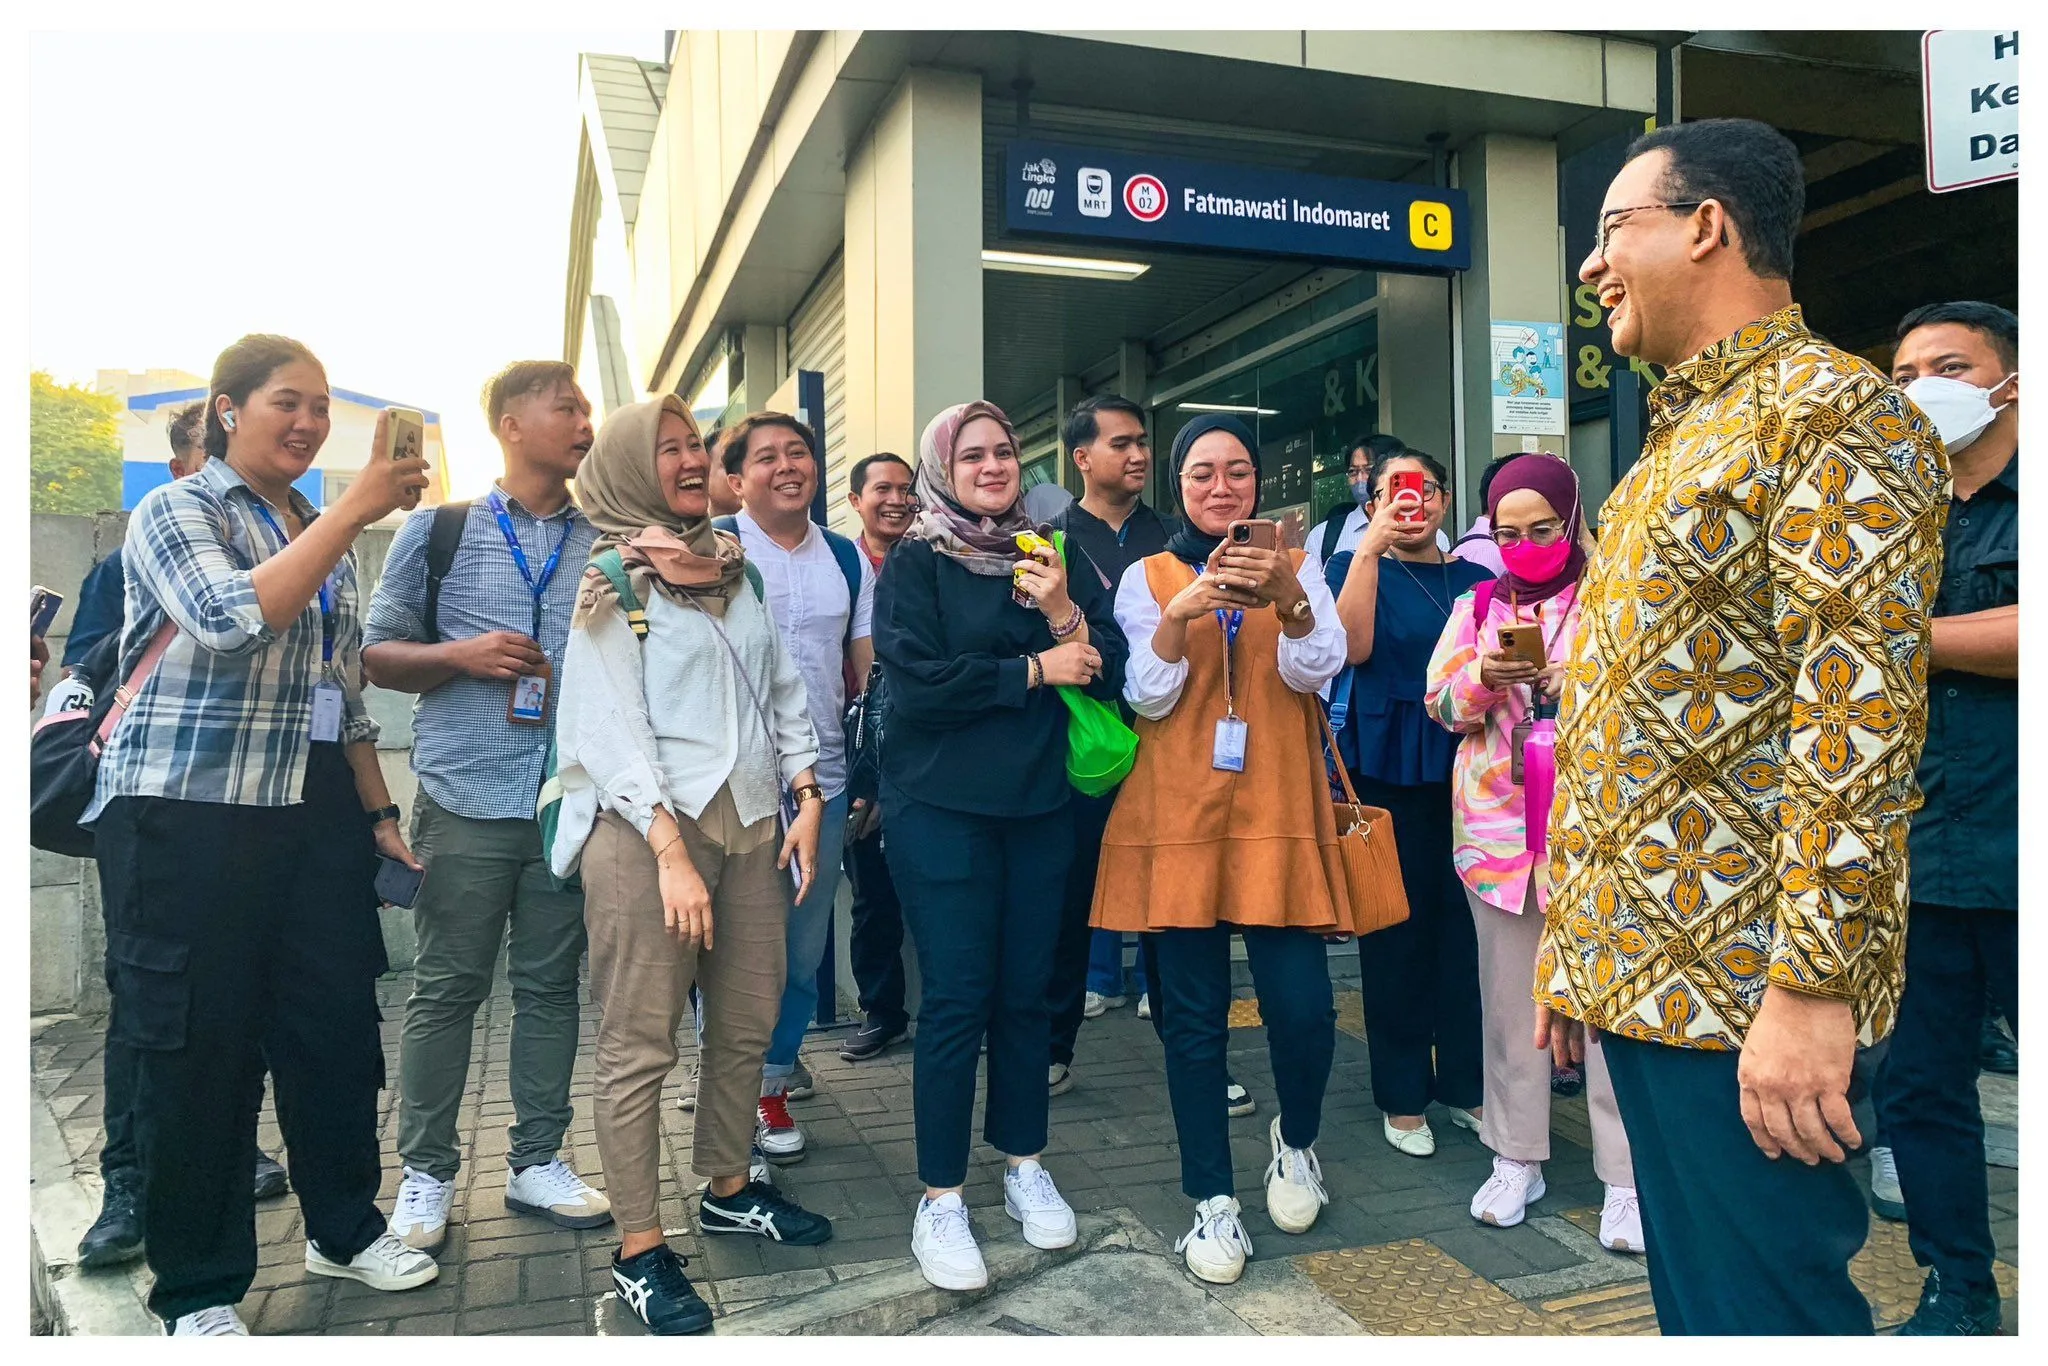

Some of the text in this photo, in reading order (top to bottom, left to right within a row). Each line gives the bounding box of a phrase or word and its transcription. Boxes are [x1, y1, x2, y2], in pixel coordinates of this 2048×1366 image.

[1022, 162, 1039, 173] Jak
[1022, 171, 1056, 185] Lingko
[1141, 186, 1150, 195] M
[1083, 199, 1107, 210] MRT
[1139, 198, 1153, 209] 02
[1183, 187, 1391, 231] Fatmawati Indomaret
[1423, 213, 1438, 237] C
[1575, 344, 1612, 389] &
